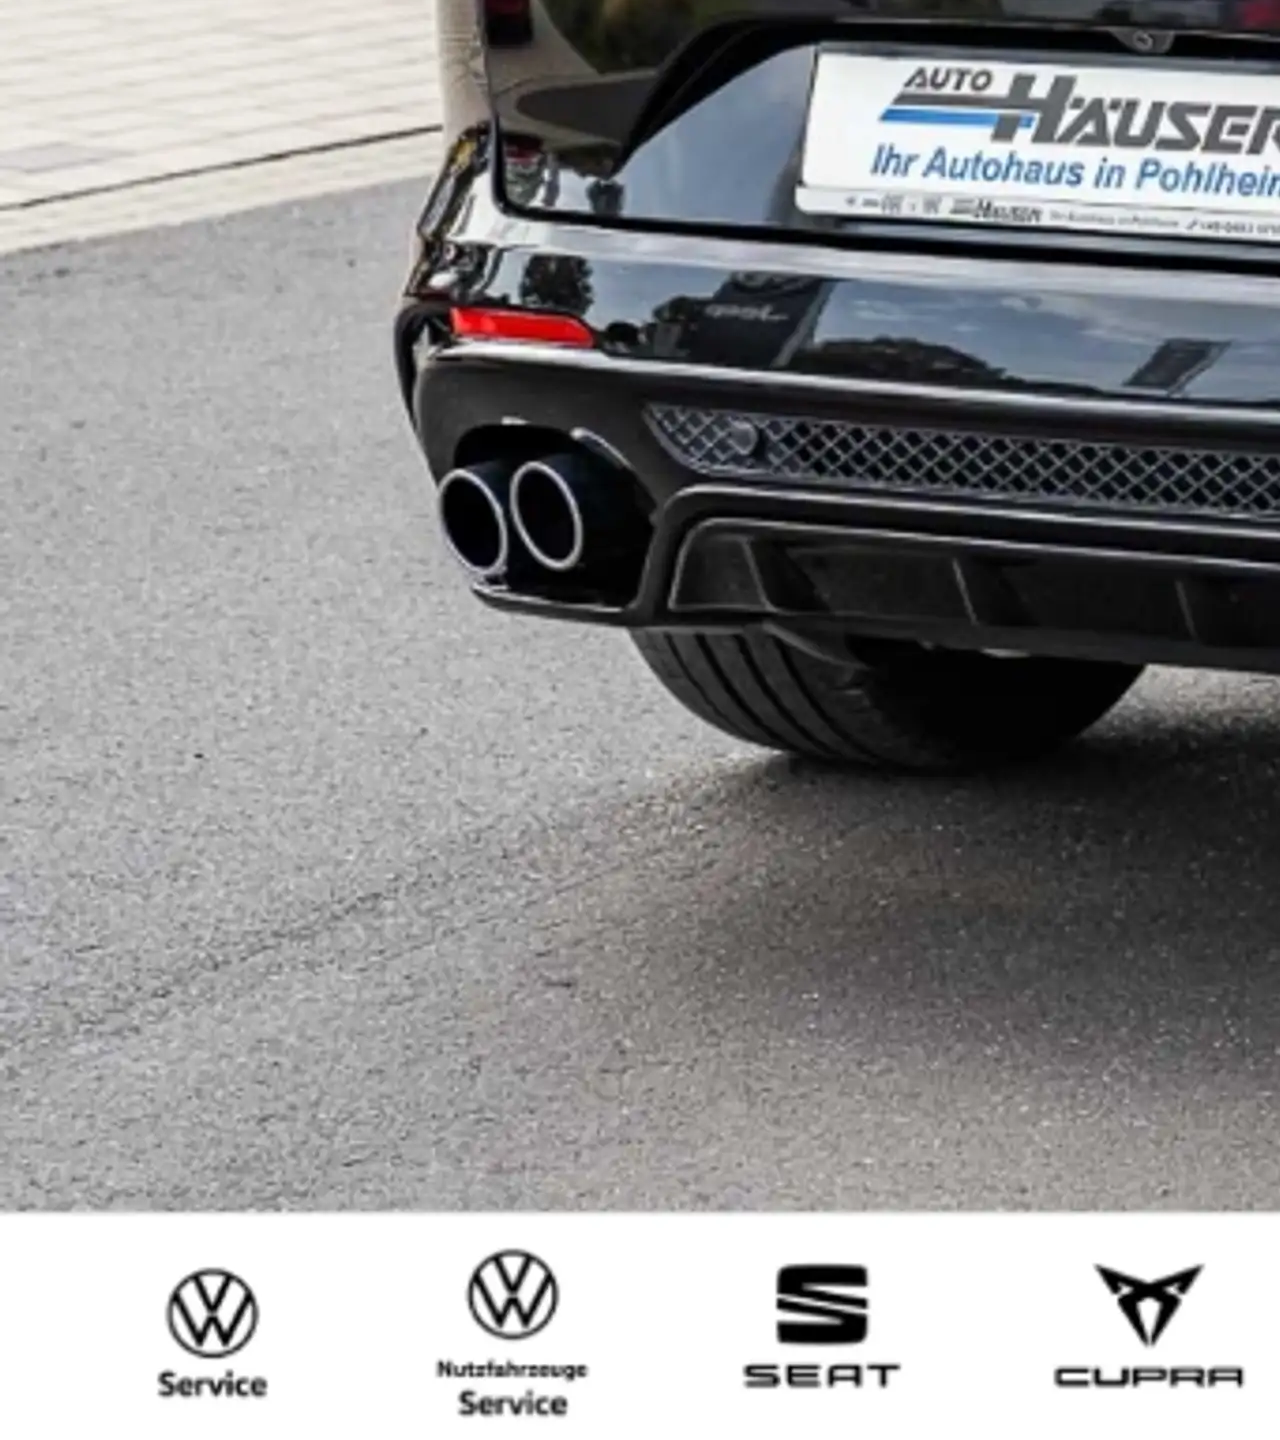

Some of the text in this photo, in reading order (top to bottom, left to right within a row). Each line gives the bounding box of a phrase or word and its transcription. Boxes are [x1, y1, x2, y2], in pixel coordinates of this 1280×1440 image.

[904, 67, 993, 92] AUTO
[870, 143, 919, 176] Ihr
[921, 146, 1085, 186] Autohaus
[1093, 157, 1127, 190] in
